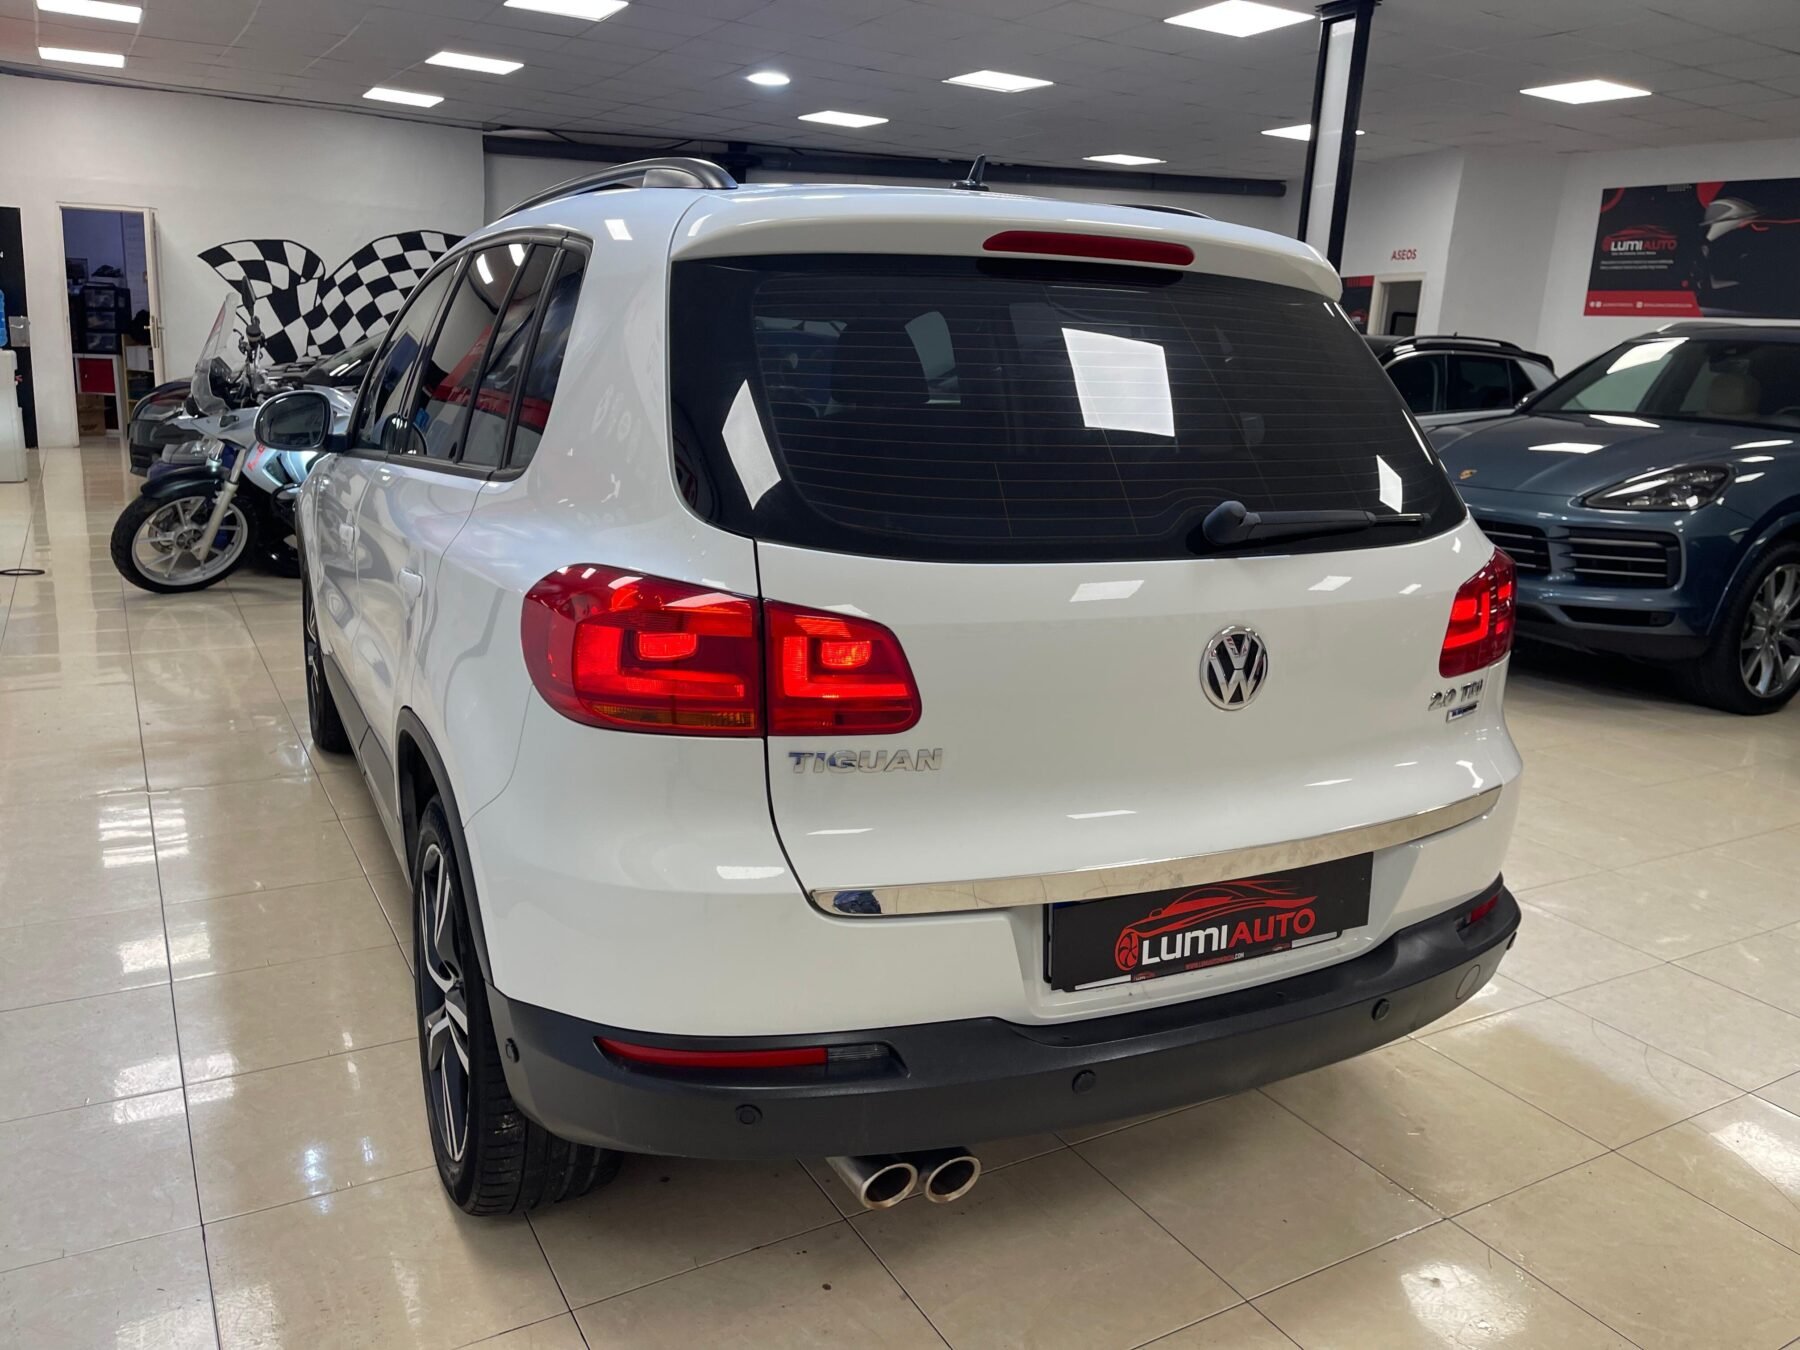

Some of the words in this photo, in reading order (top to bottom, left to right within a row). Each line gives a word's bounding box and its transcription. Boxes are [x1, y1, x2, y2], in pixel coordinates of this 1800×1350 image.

[1391, 249, 1417, 261] ASEOS
[1203, 628, 1265, 708] VW
[788, 748, 943, 774] TIGUAN
